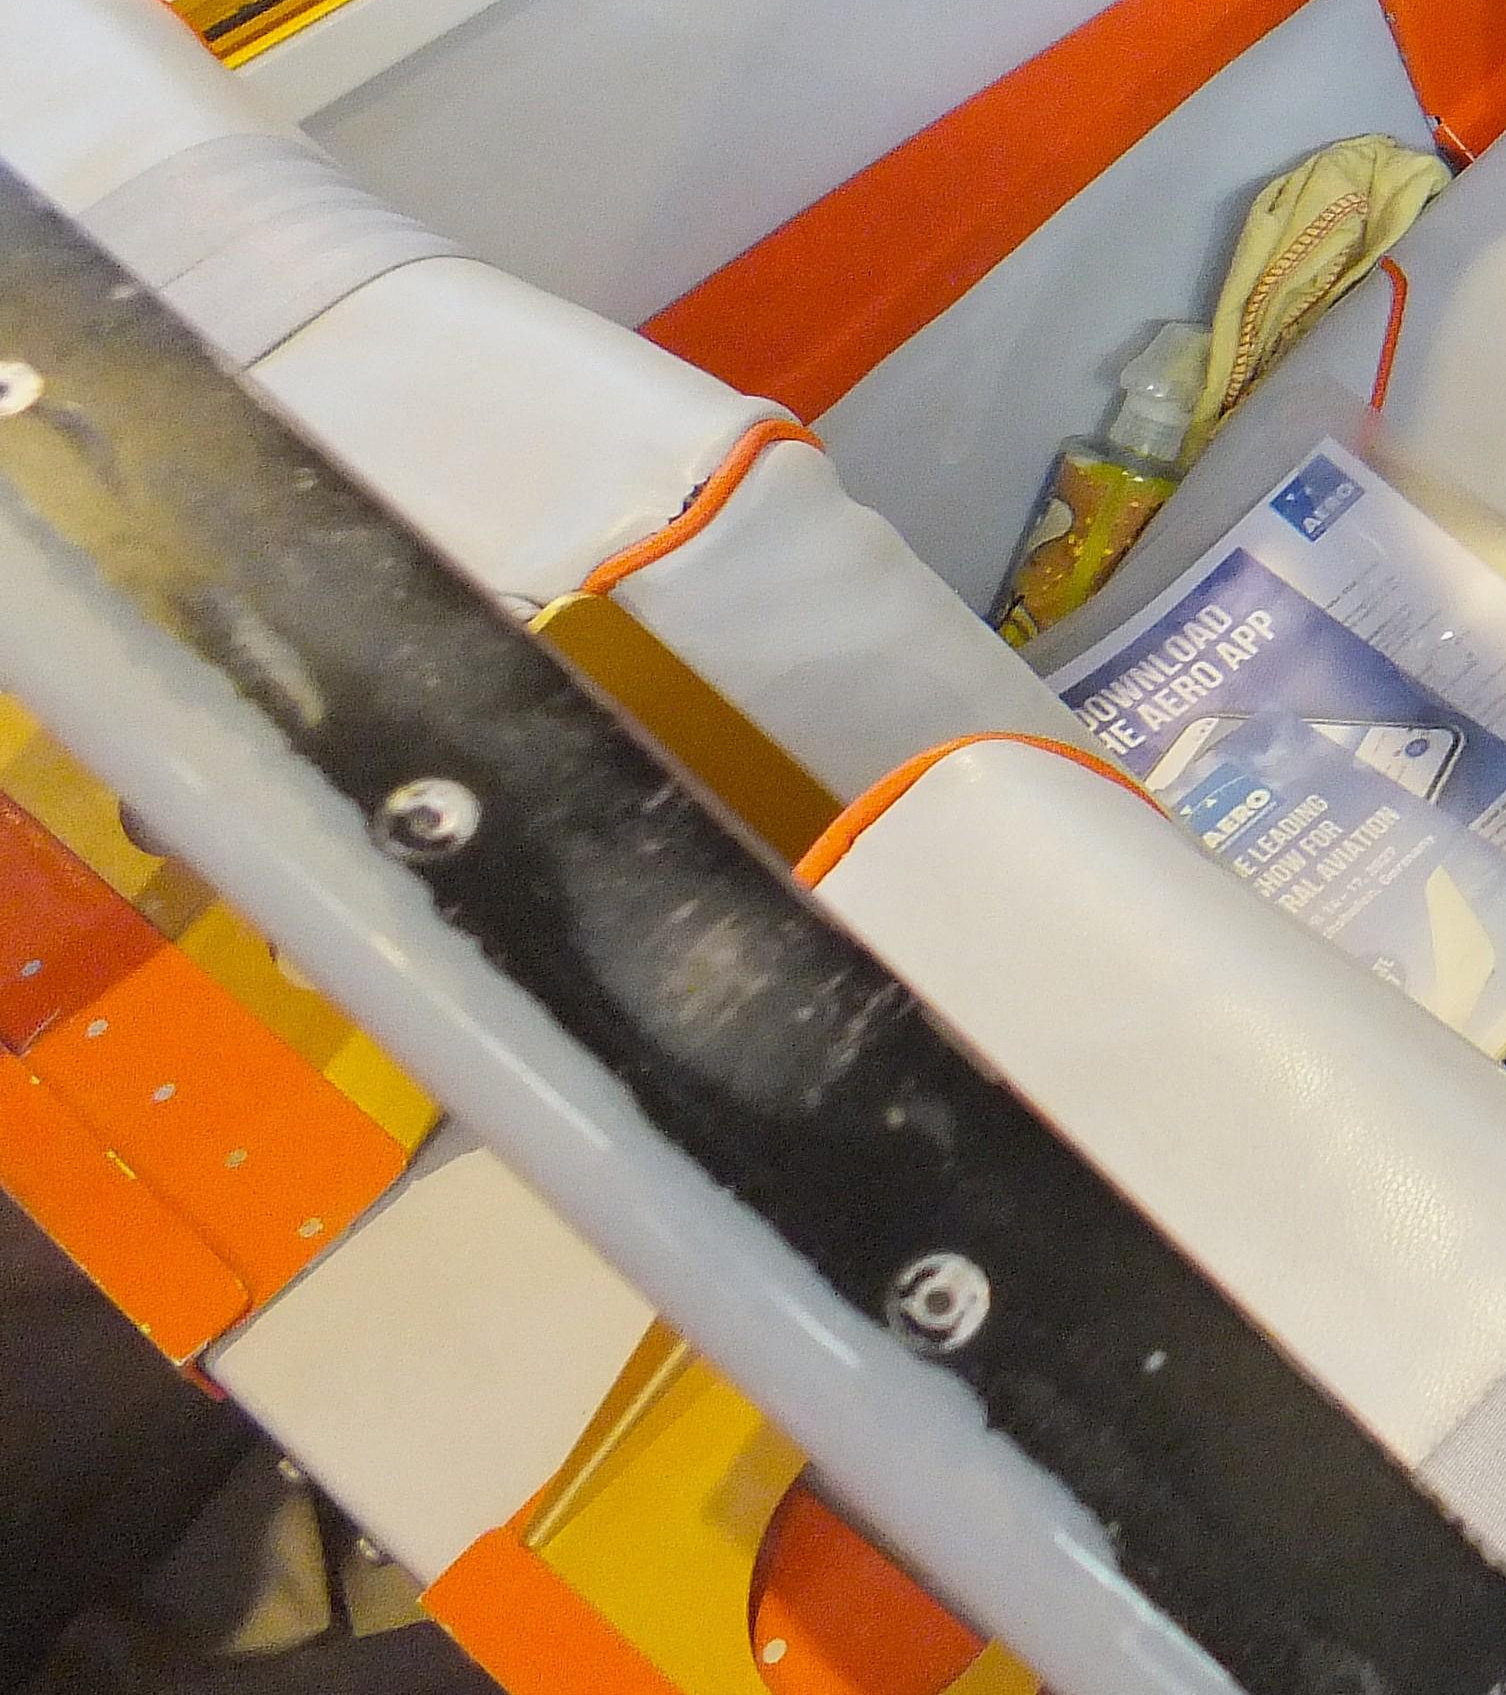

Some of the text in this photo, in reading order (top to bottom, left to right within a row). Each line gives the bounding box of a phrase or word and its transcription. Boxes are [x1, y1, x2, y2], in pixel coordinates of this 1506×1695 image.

[1140, 661, 1224, 732] AERO
[1216, 609, 1276, 671] APP
[1201, 788, 1272, 849] AERO
[1248, 793, 1328, 862] LEADING
[1299, 819, 1344, 857] FOR
[1315, 805, 1401, 883] AVIATION
